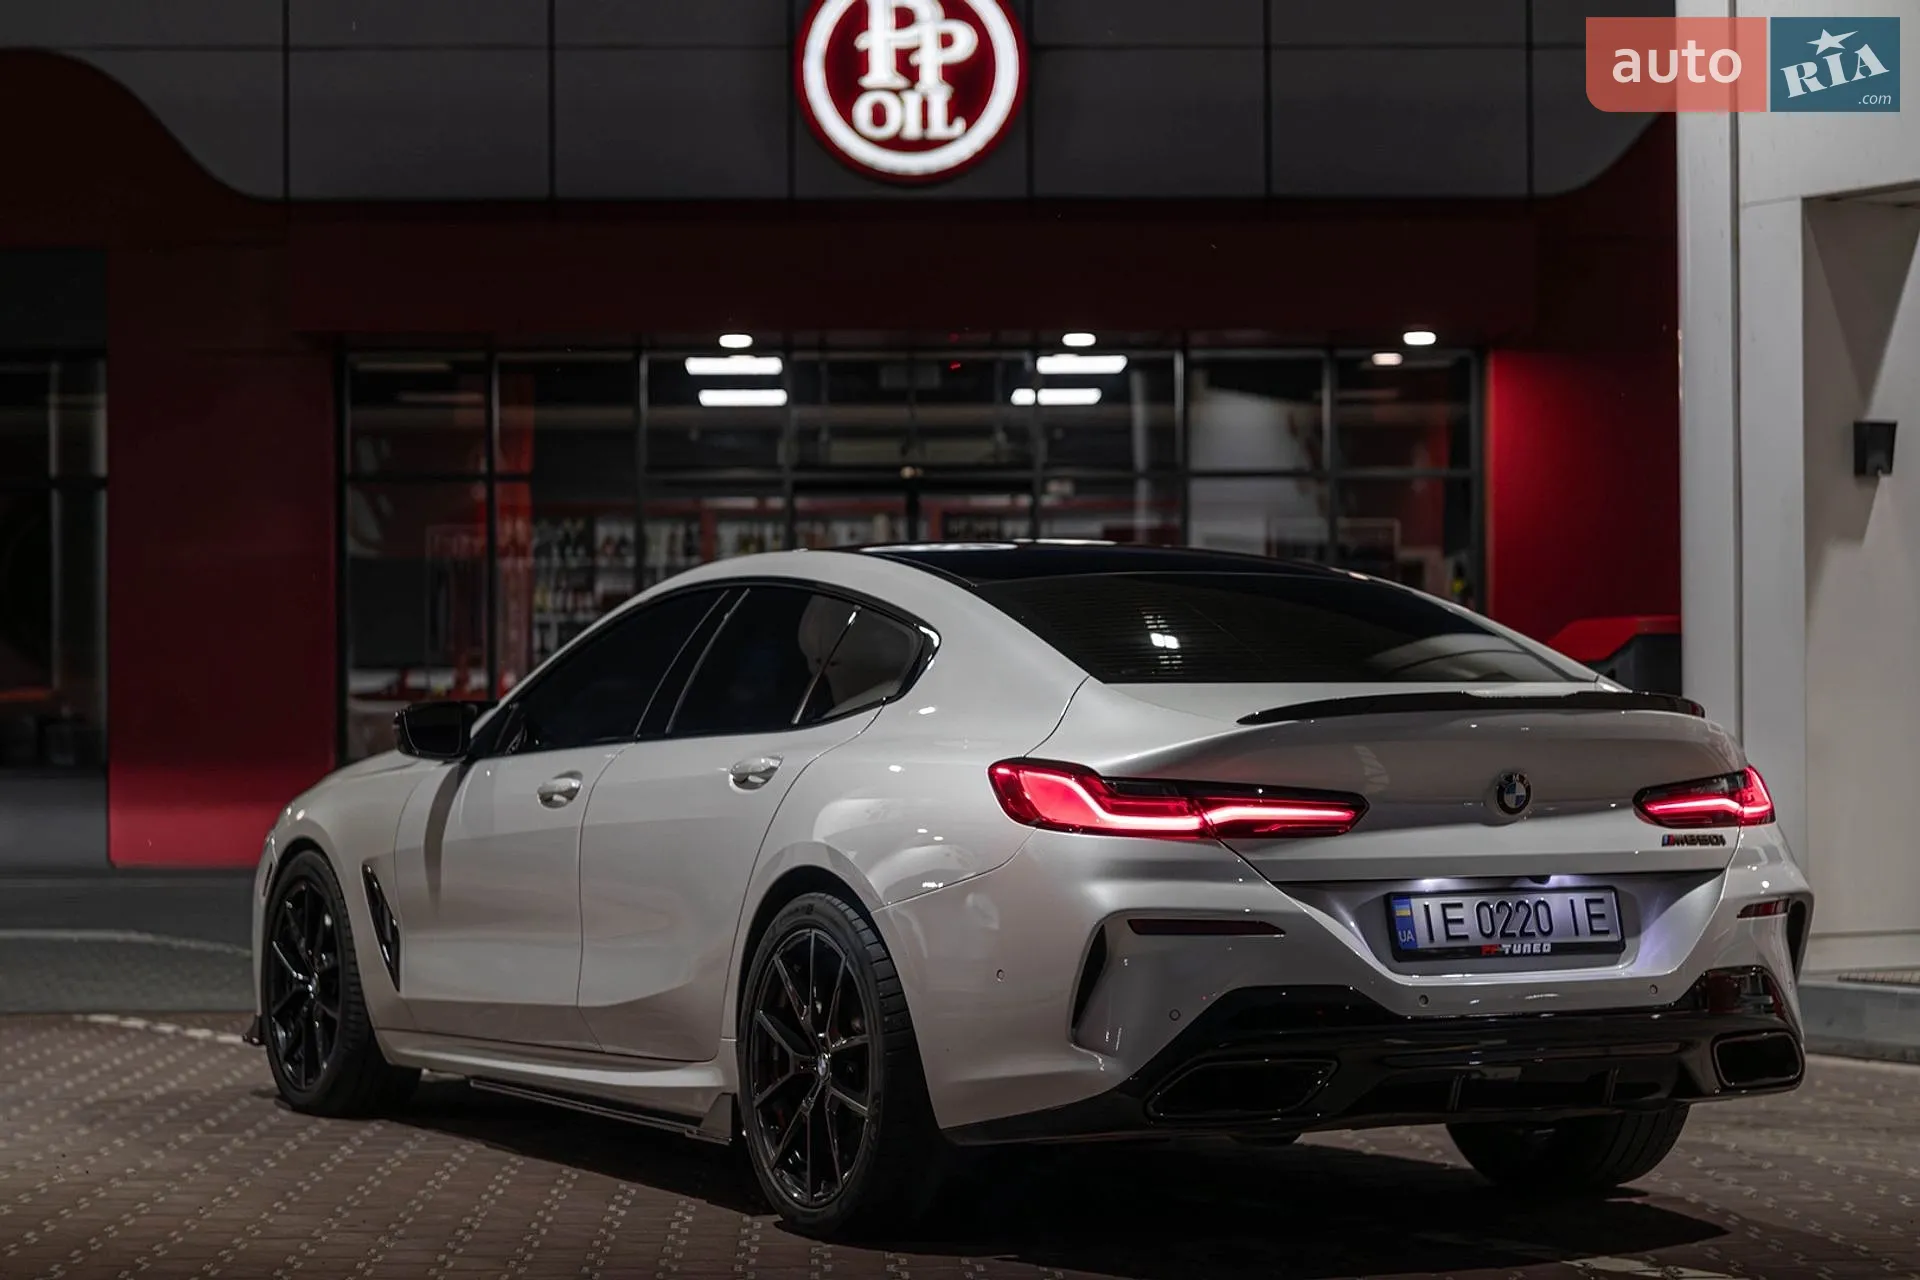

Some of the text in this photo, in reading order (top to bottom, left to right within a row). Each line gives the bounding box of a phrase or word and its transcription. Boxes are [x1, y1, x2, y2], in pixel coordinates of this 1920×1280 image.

[852, 89, 966, 141] OIL
[1398, 930, 1415, 943] UA
[1423, 898, 1610, 944] IE 0220 IE
